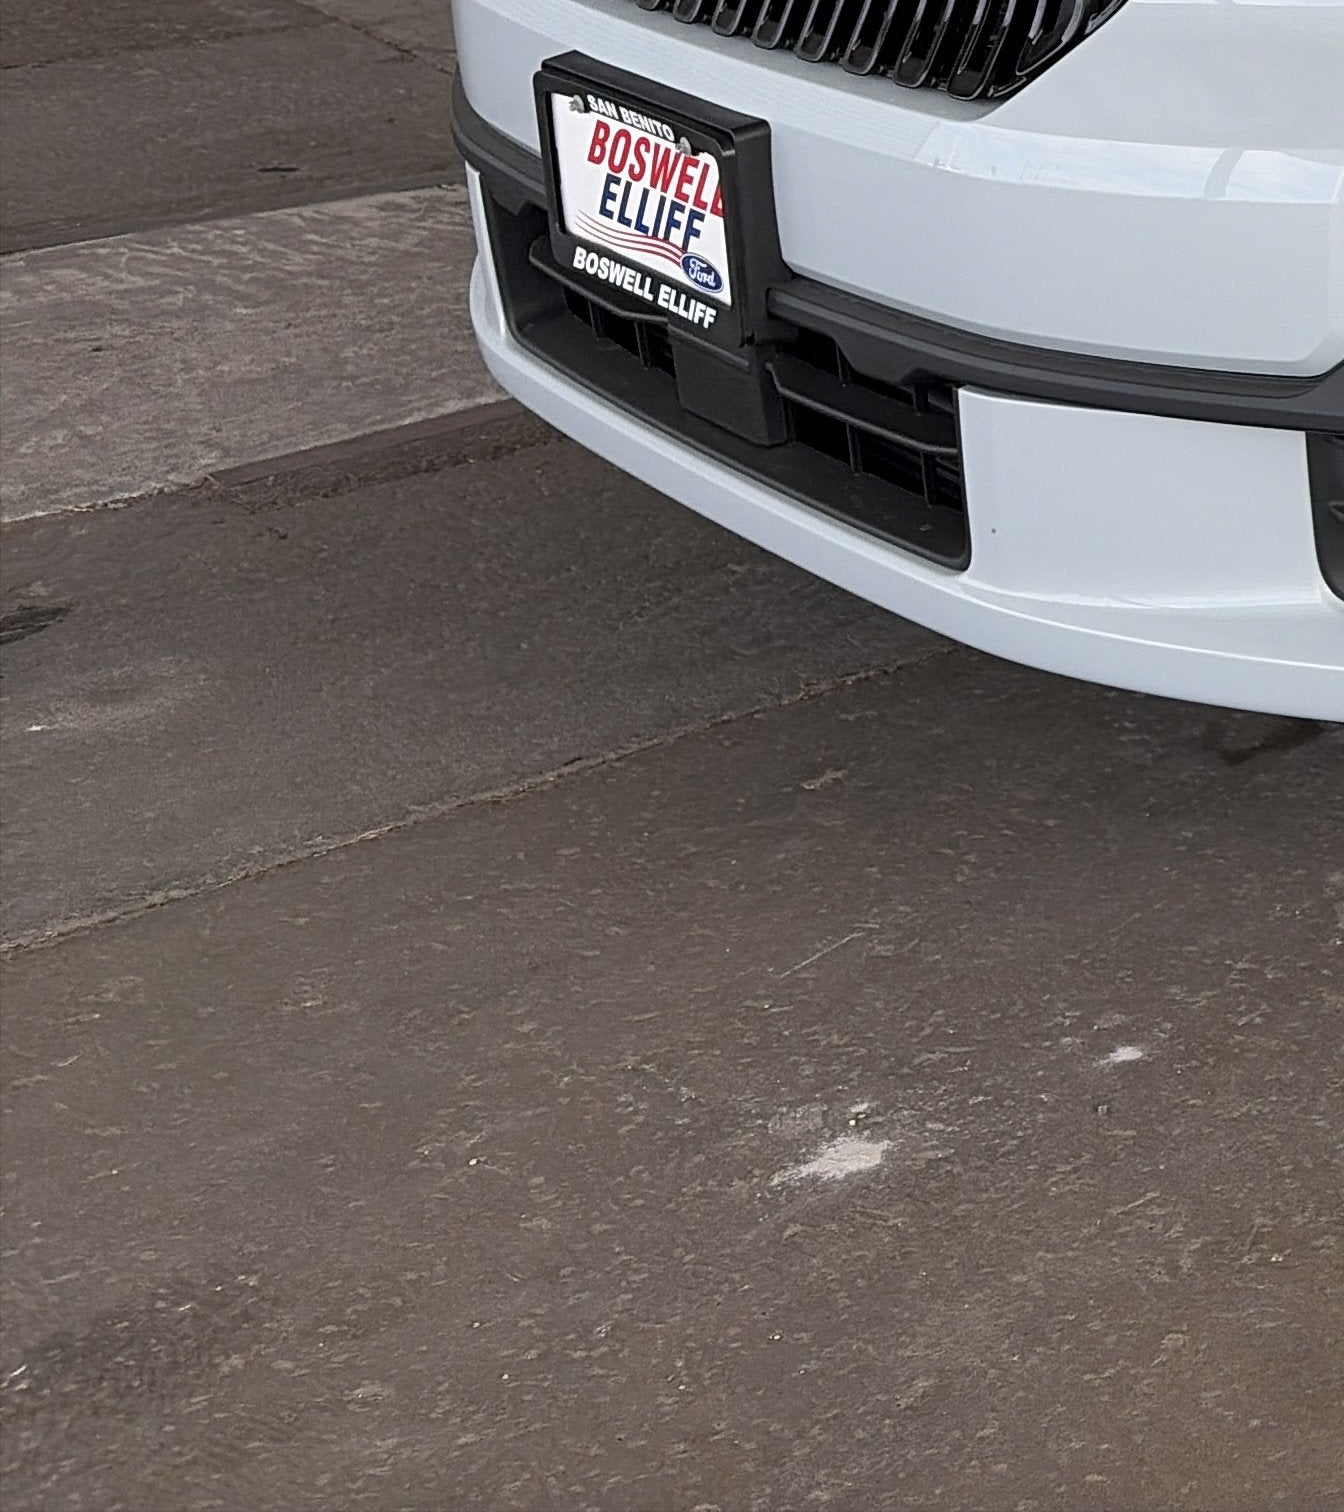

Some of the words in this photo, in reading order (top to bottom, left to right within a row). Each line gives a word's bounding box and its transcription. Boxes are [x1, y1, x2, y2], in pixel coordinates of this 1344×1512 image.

[586, 94, 618, 121] SAN
[619, 106, 675, 141] BENITO
[587, 119, 726, 218] BOSWELL
[599, 172, 706, 253] ELLIFF
[572, 246, 654, 302] BOSWELL
[657, 287, 717, 329] ELLIFF
[688, 257, 716, 288] Ford
